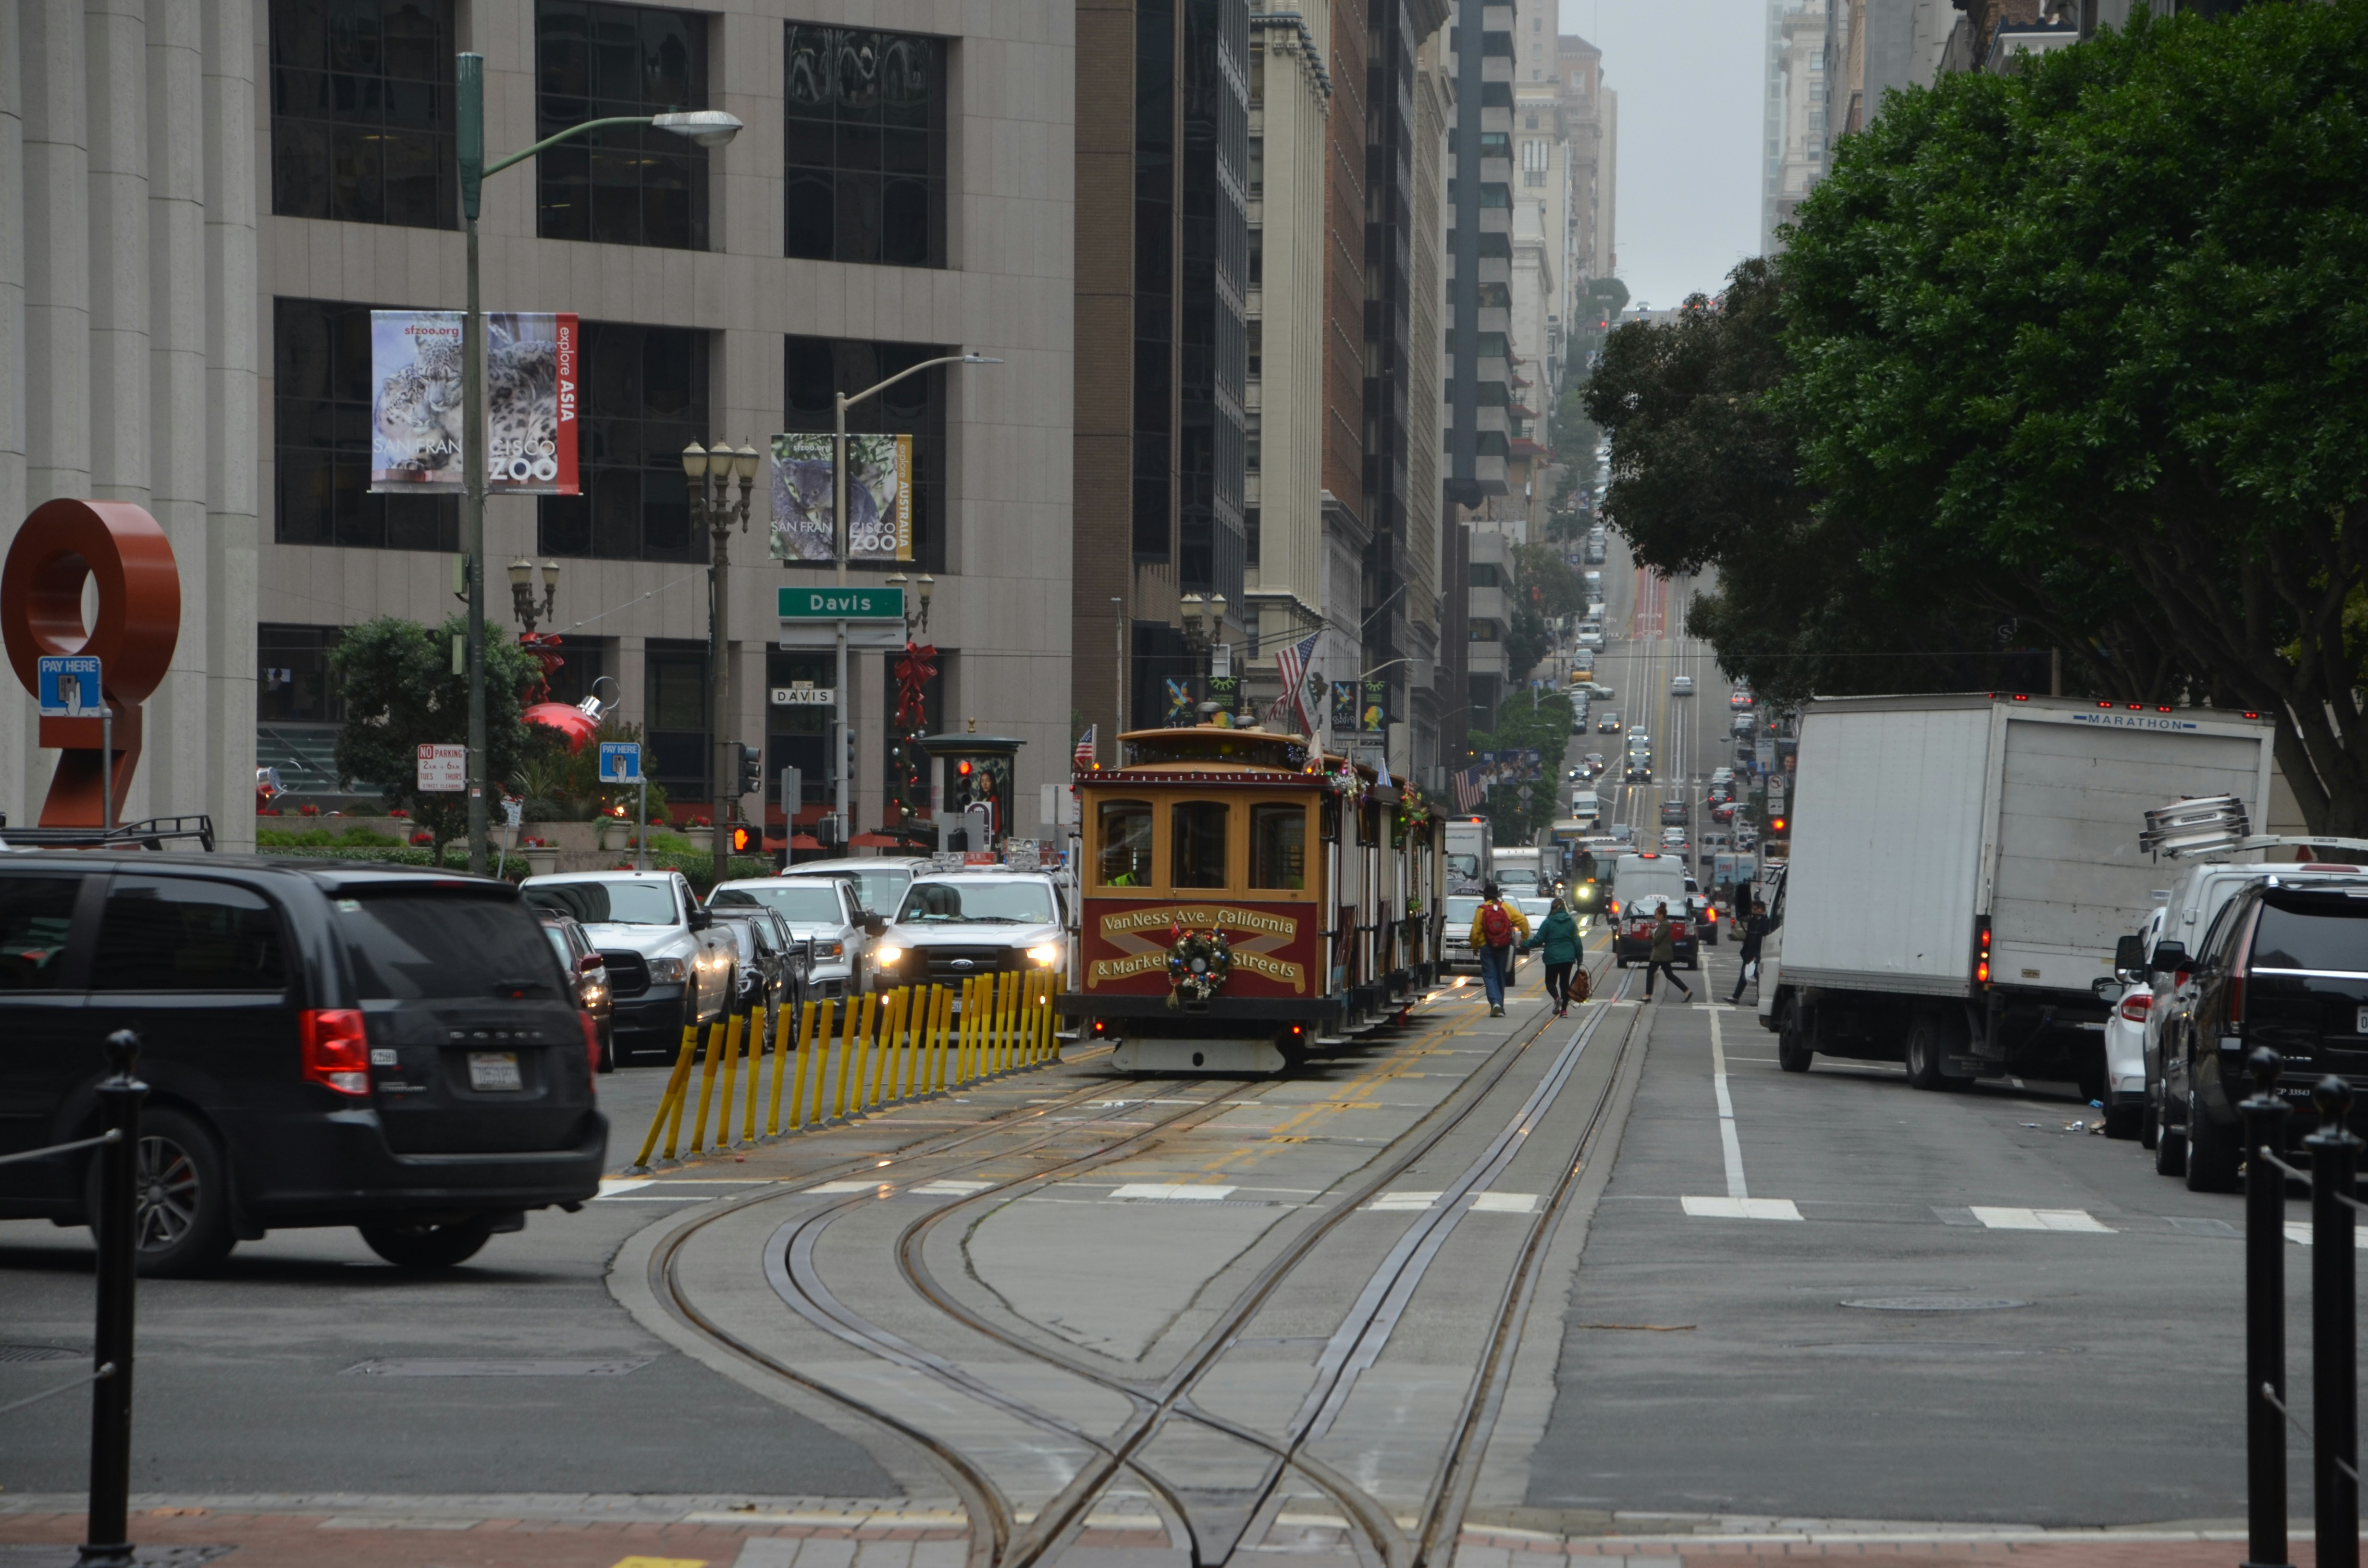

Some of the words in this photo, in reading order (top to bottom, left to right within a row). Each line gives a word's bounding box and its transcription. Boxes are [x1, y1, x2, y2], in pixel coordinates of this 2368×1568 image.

[405, 325, 459, 337] sfzoo.org
[557, 327, 574, 376] explore
[561, 380, 574, 422] ASIA
[373, 438, 410, 454] SAN
[416, 438, 461, 454] FRAN
[490, 440, 555, 456] CISCO
[793, 444, 831, 452] sfzoo.org
[898, 444, 909, 478] explore
[490, 458, 557, 481] ZOO
[900, 481, 909, 547] AUSTRALIA
[771, 522, 797, 532] SAN
[801, 522, 832, 532] FRAN
[850, 522, 895, 534] CISCO
[850, 535, 897, 551] ZOO
[810, 595, 871, 610] Davis
[42, 660, 63, 672] PAY
[66, 660, 96, 672] HERE
[777, 691, 827, 701] DAVIS
[2089, 714, 2182, 730] MARATHON
[419, 746, 432, 758] NO
[435, 749, 462, 758] PARKING
[603, 745, 617, 753] PAY
[617, 745, 638, 753] HERE
[1104, 917, 1131, 930] Van
[1133, 913, 1170, 927] Ness
[1217, 910, 1294, 934] California
[1098, 962, 1109, 975] &
[1113, 953, 1167, 975] Market
[1232, 953, 1296, 977] Streets
